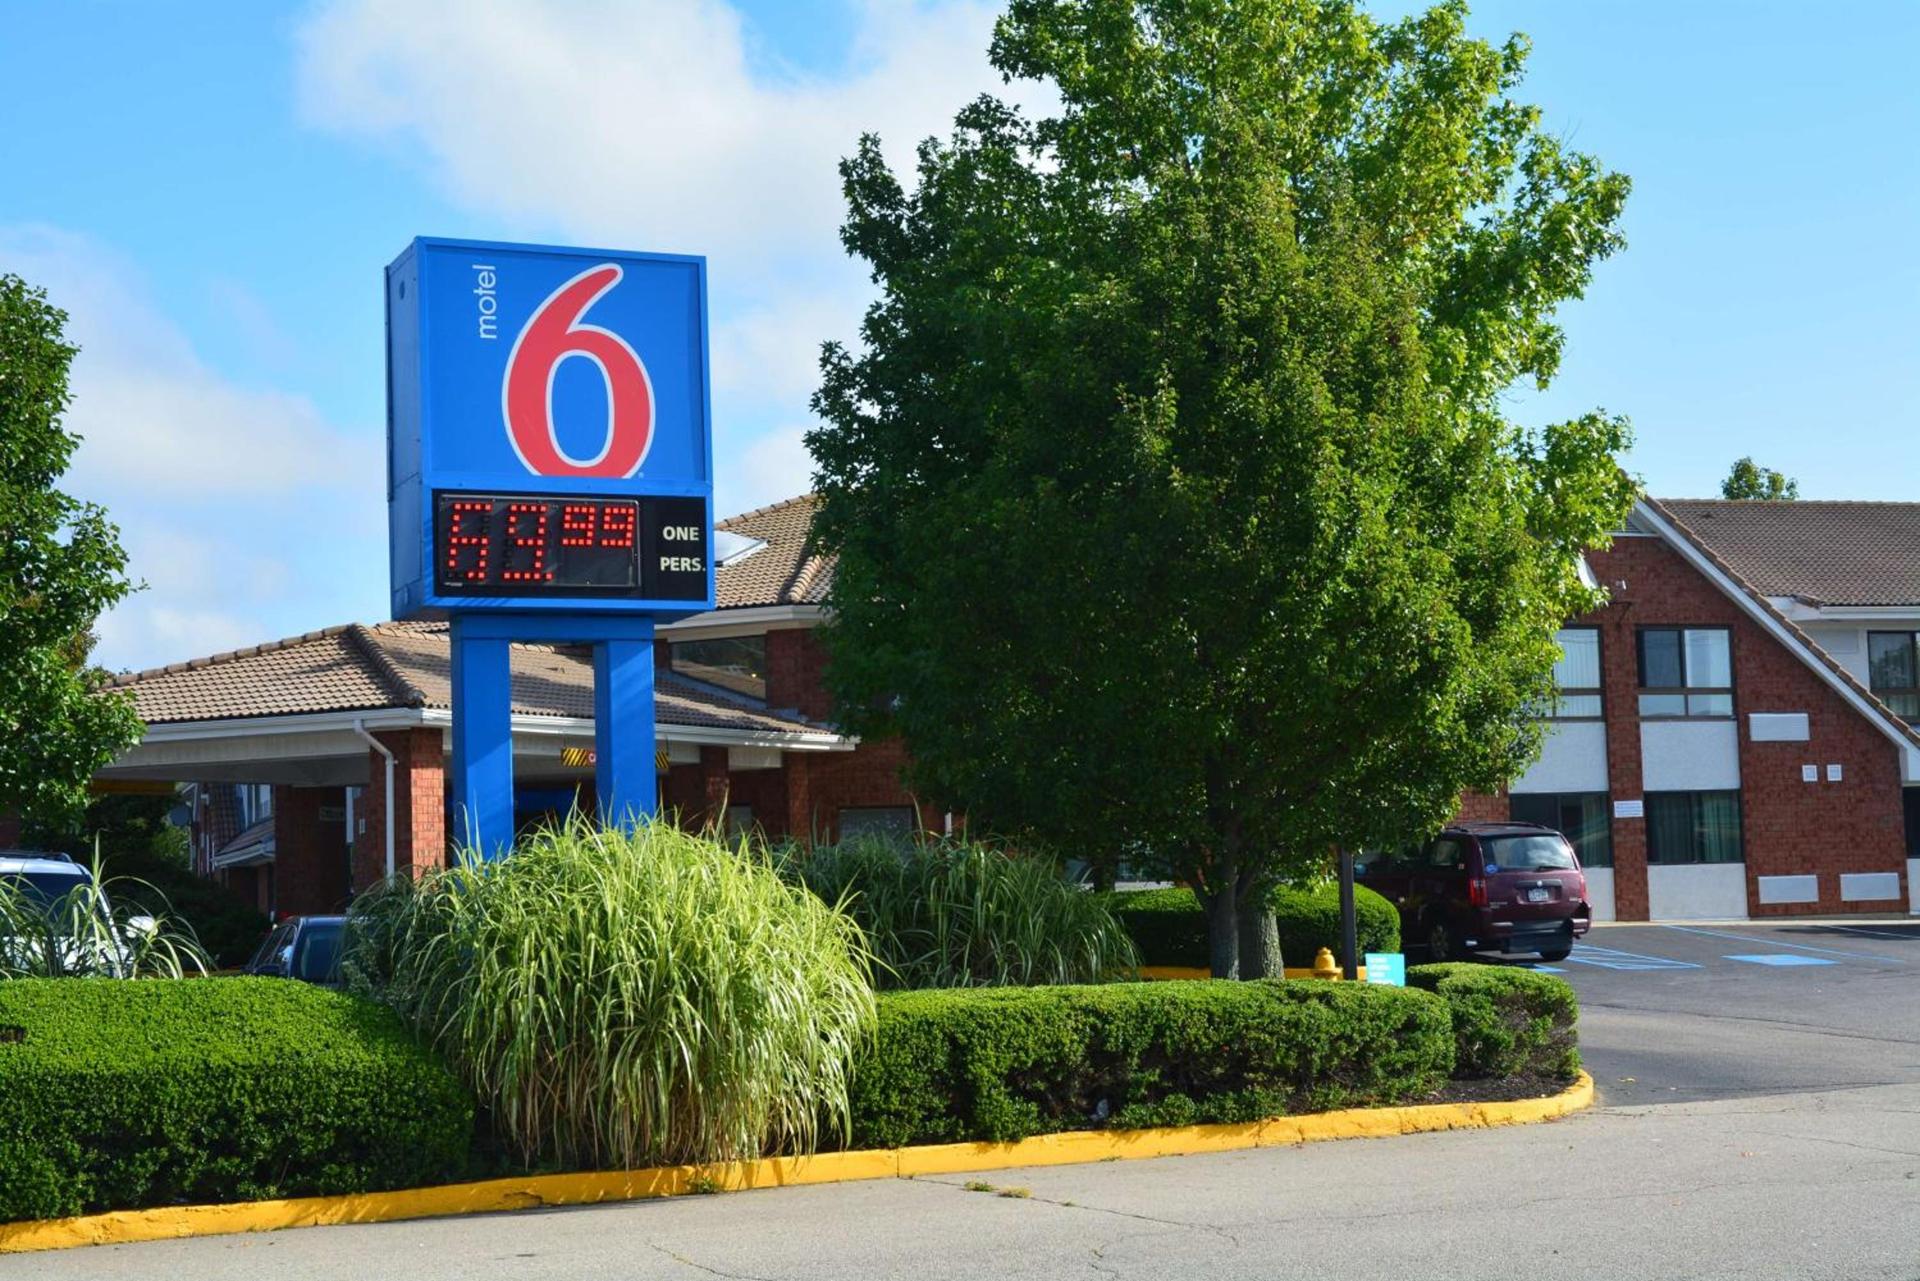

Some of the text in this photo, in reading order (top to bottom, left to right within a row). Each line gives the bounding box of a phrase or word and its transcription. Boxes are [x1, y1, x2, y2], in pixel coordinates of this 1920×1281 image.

[472, 264, 497, 339] motel
[501, 263, 656, 479] 6
[662, 526, 700, 541] ONE
[660, 556, 706, 572] PERS.
